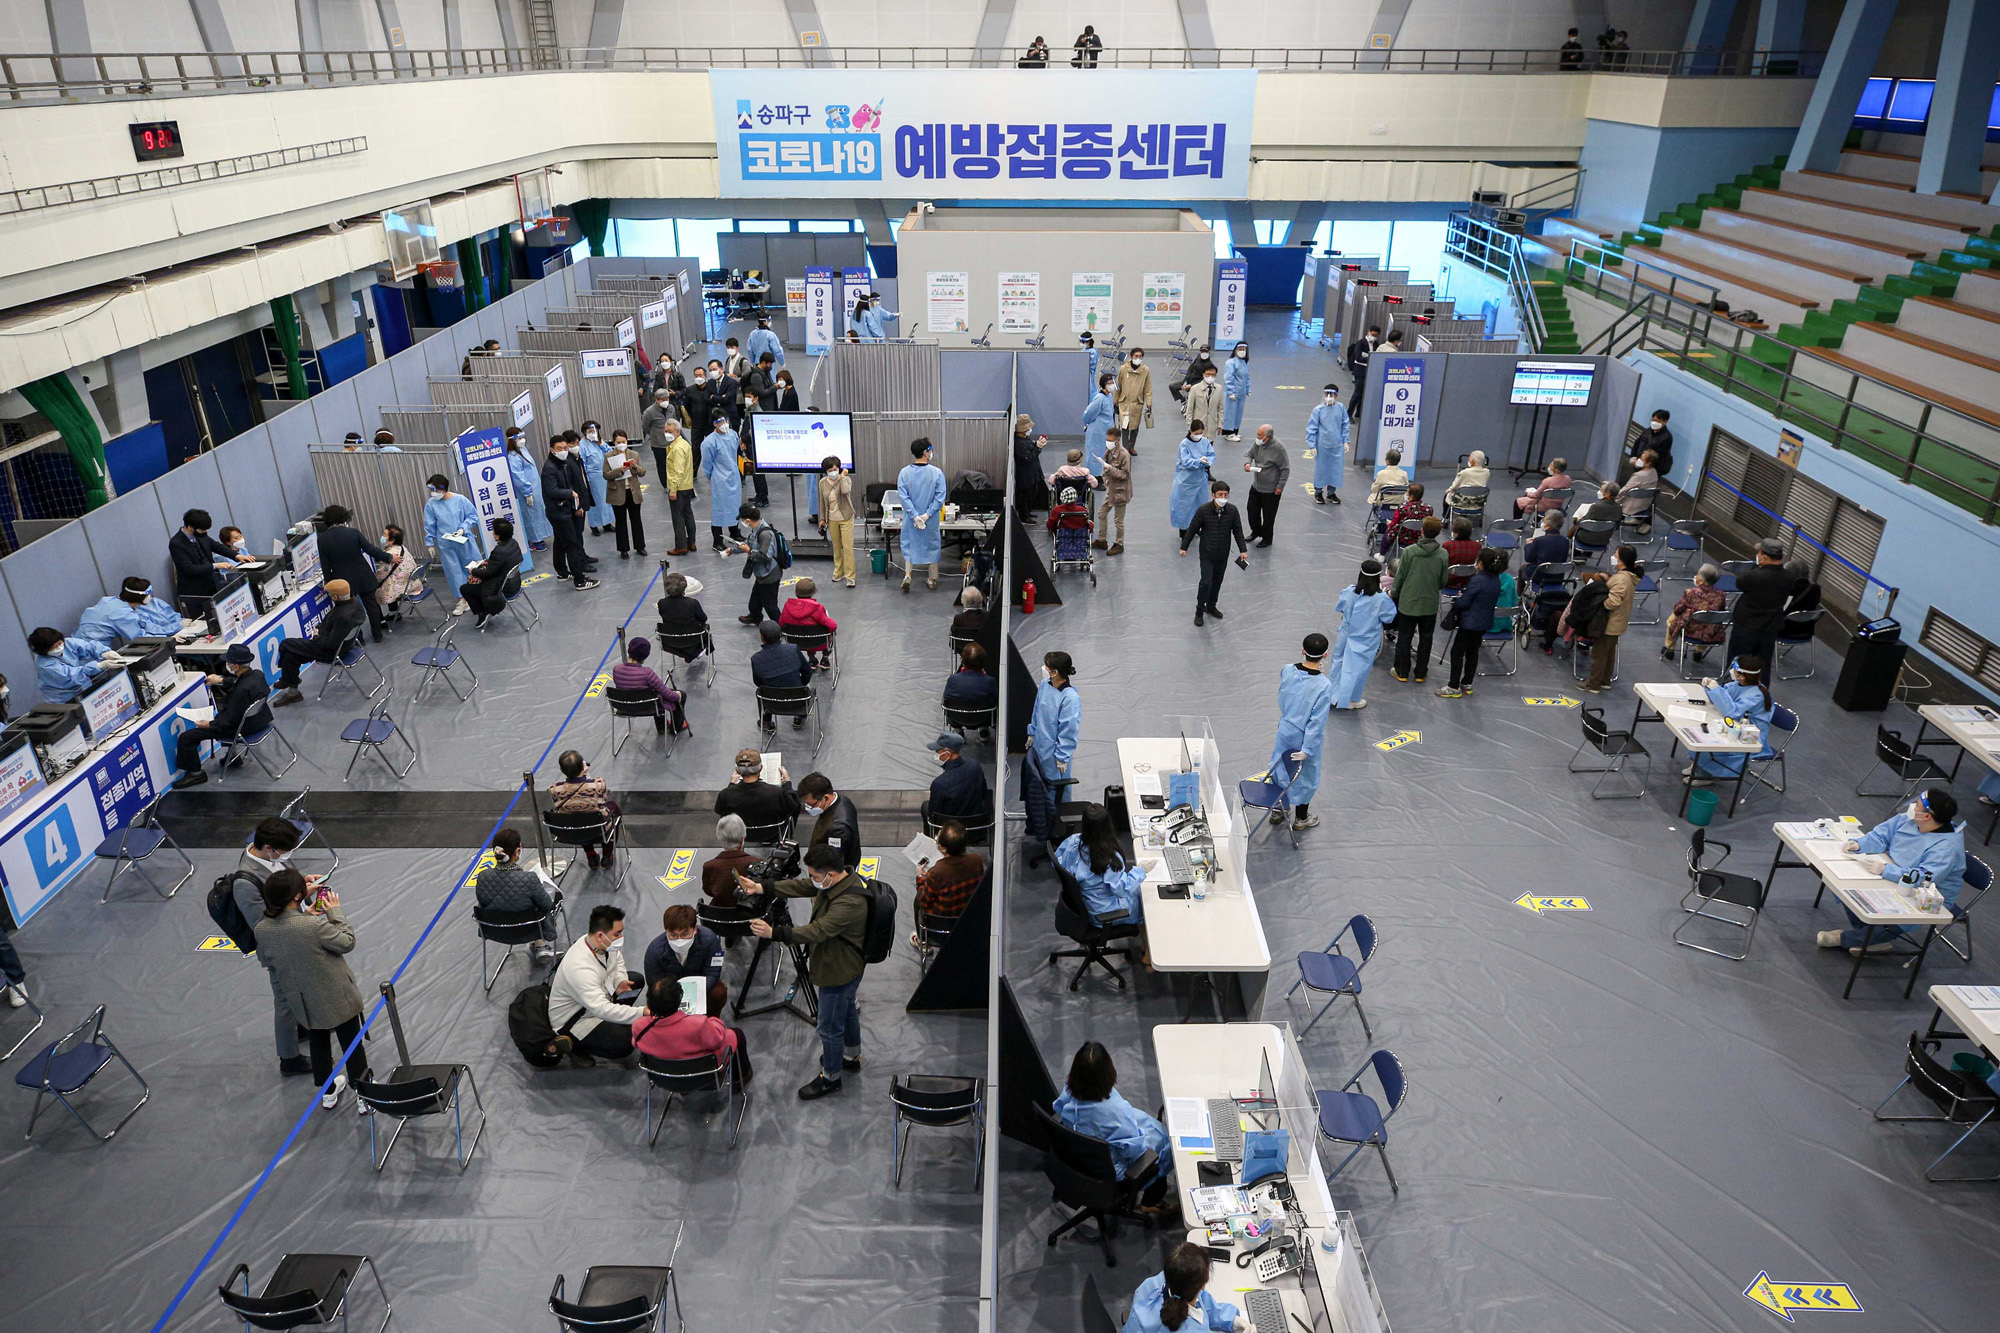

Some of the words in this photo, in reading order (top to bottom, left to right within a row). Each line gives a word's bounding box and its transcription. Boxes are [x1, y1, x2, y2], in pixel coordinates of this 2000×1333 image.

[757, 104, 811, 125] 송파구
[747, 140, 876, 174] 코로나19
[895, 123, 1226, 180] 예방접종센터
[1227, 295, 1235, 321] 예진실
[597, 358, 624, 367] 접종실
[1397, 389, 1408, 400] 3
[1384, 417, 1415, 428] 대기실
[466, 447, 503, 462] 예방접종센터
[483, 468, 494, 481] 7
[267, 636, 283, 676] 2
[100, 763, 147, 812] 접종내역
[45, 819, 68, 868] 4
